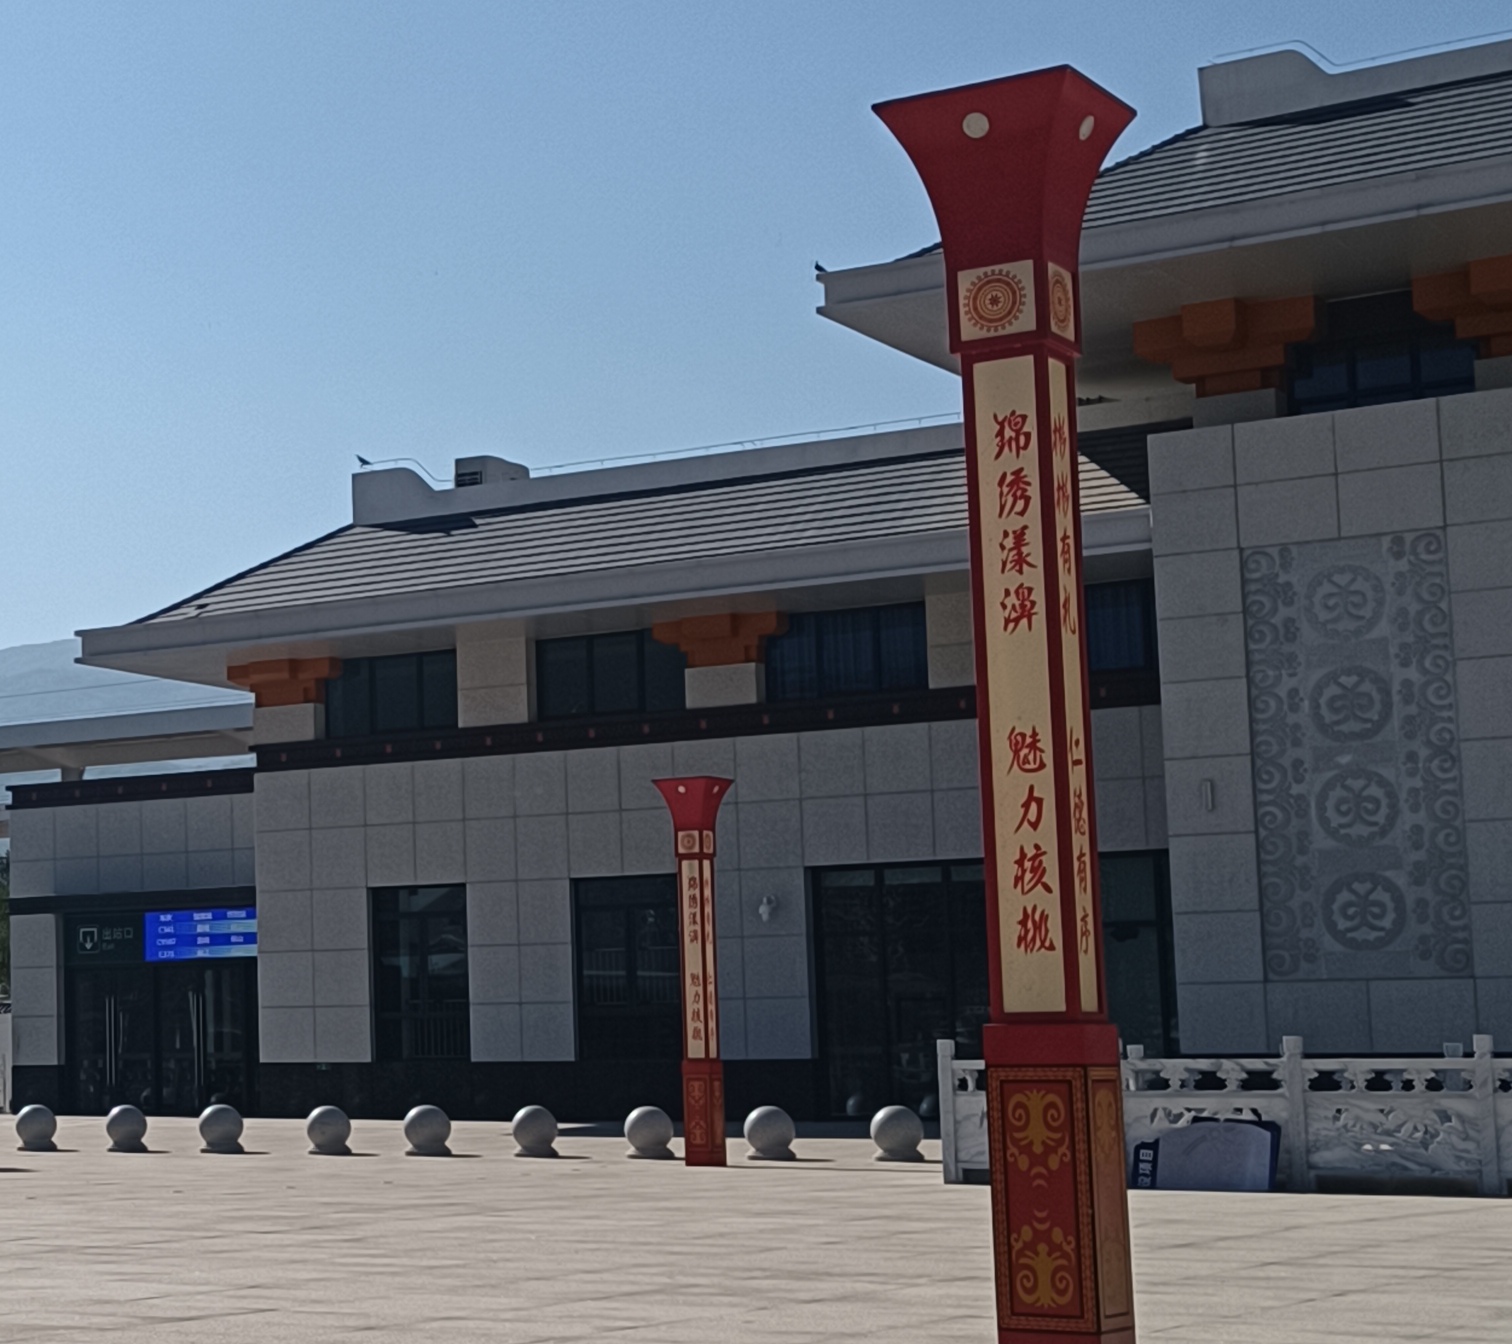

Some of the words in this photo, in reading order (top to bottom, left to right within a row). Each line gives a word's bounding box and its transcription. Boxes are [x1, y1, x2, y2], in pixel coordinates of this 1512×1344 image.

[993, 409, 1038, 635] 锦绣漾濞
[102, 926, 134, 940] 出站口
[1005, 724, 1056, 955] 魅力核桃
